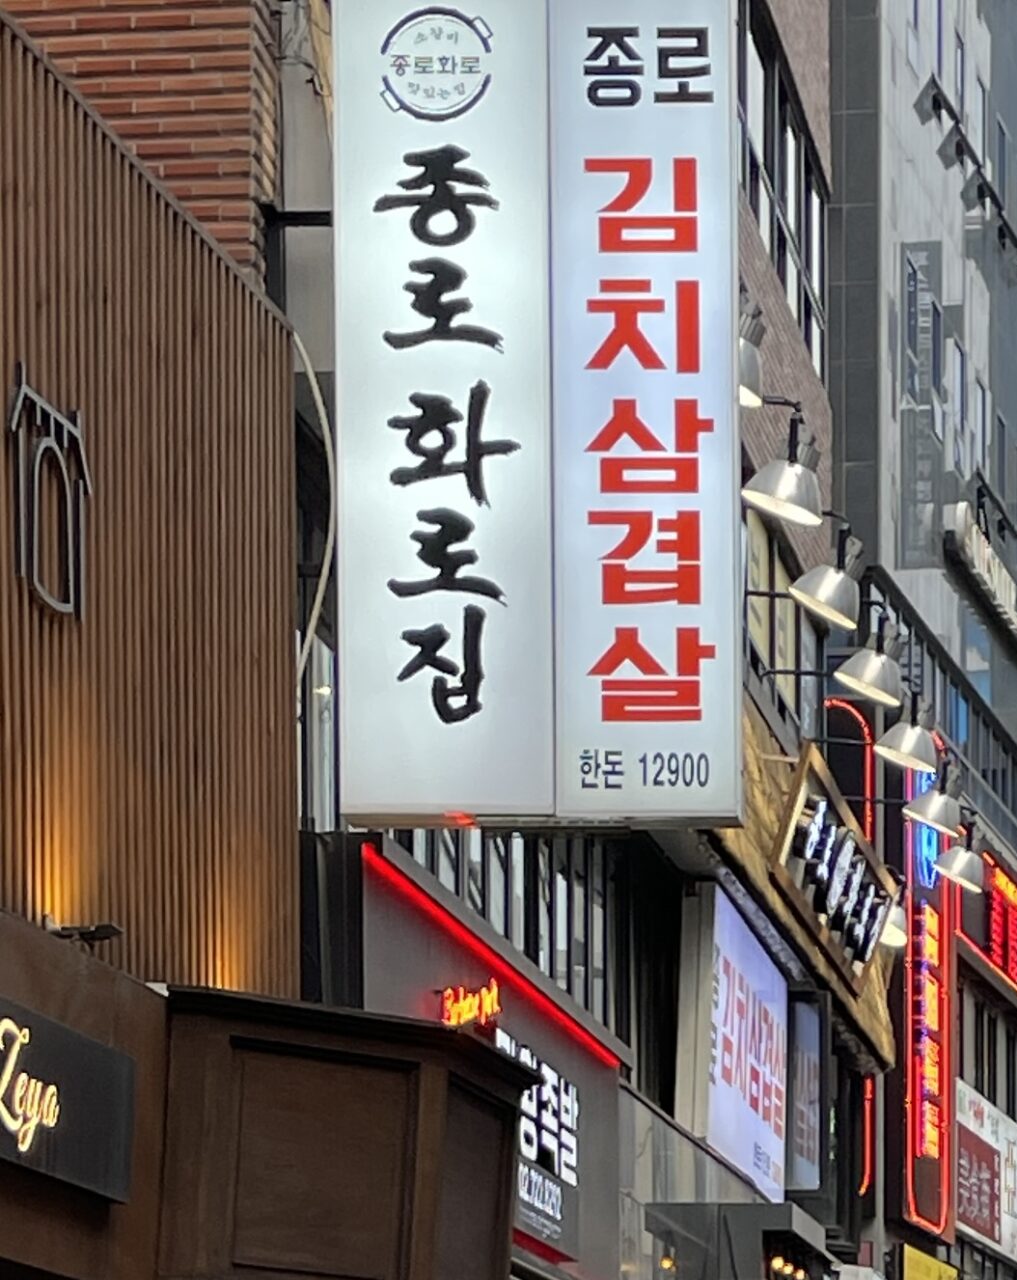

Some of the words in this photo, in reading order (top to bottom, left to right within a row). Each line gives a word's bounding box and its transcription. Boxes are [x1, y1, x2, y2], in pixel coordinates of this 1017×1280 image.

[390, 54, 481, 77] 종로화로
[583, 26, 715, 107] 종로
[583, 157, 716, 723] 김치삼겹살
[579, 748, 625, 789] 한돈
[638, 754, 711, 789] 12900
